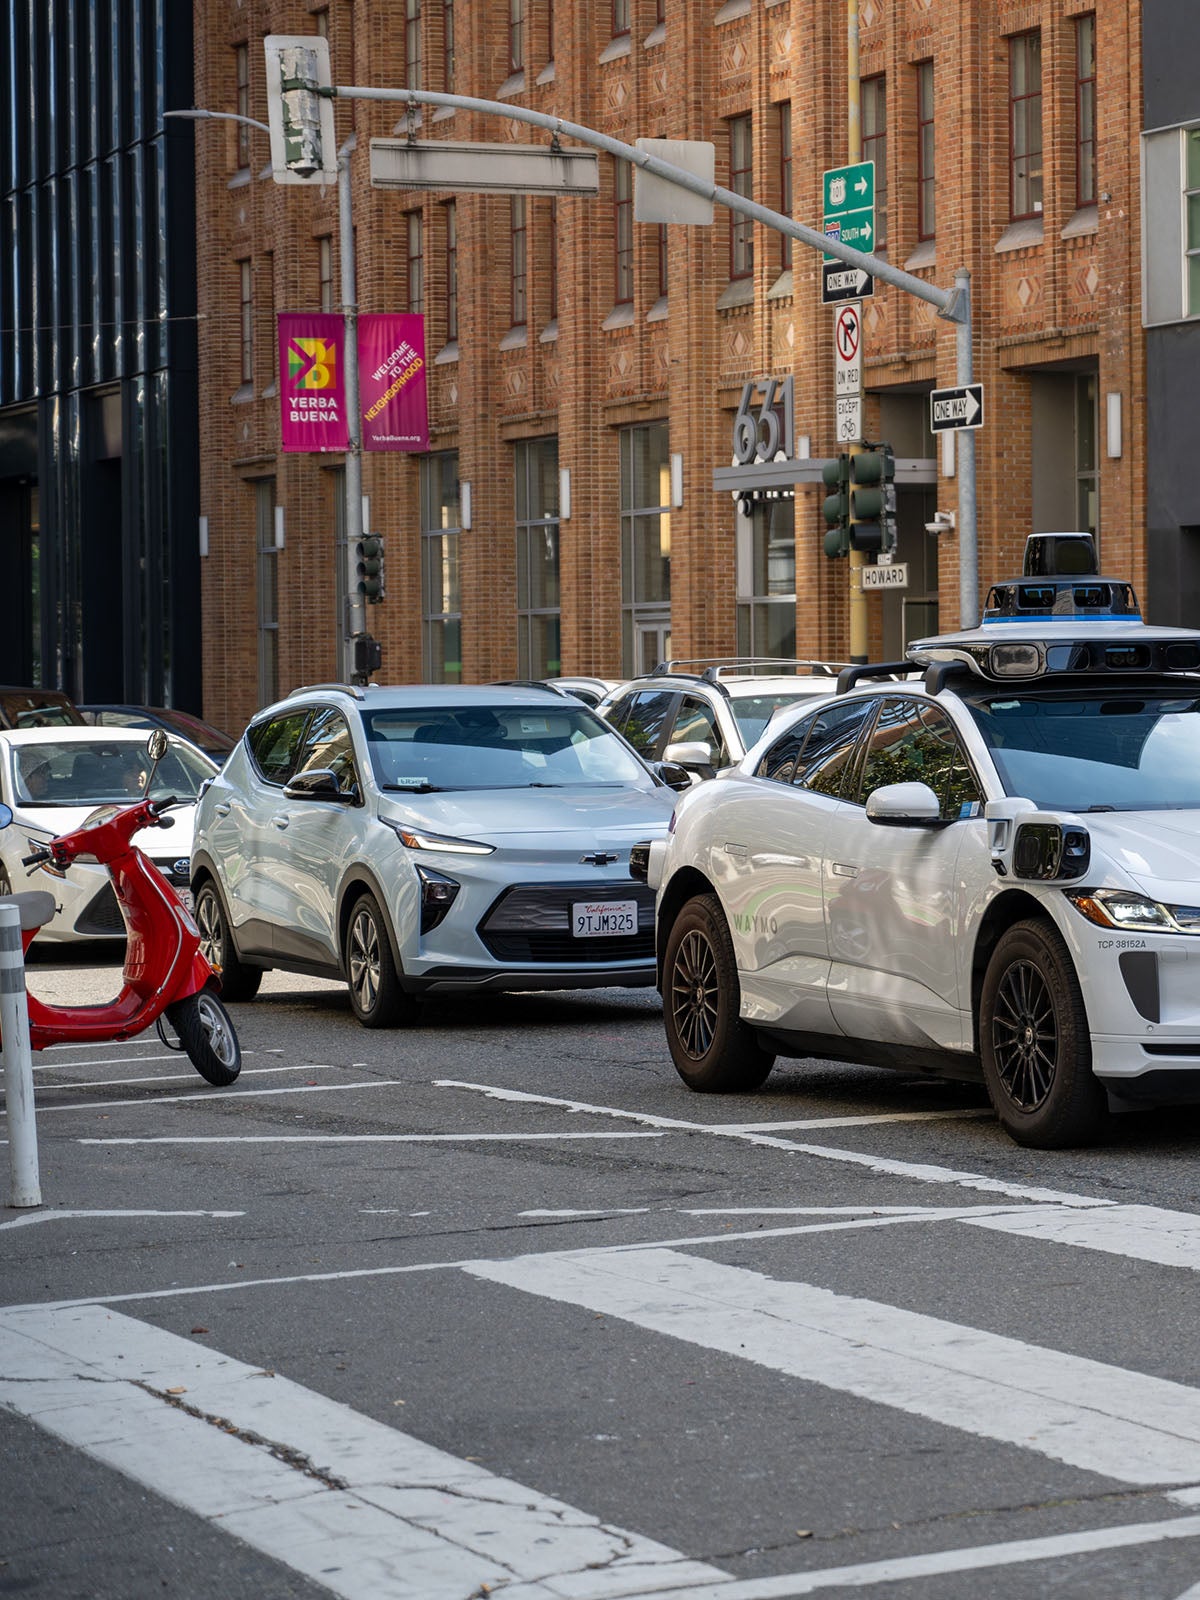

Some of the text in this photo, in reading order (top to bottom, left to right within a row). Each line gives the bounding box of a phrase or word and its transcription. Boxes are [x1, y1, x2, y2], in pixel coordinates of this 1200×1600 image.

[832, 186, 842, 198] 101
[841, 227, 859, 241] SOUTH
[828, 272, 858, 289] ONE WAY
[371, 340, 410, 382] WELCOME
[388, 348, 418, 379] TO THE
[838, 368, 858, 385] ON RED
[364, 357, 424, 422] NEIGHBORHOOD
[289, 397, 338, 409] YERBA
[838, 401, 859, 415] EXCEPT
[936, 399, 967, 420] ONE WAY
[290, 411, 339, 422] BUENA
[734, 375, 795, 464] 631
[865, 569, 904, 584] HOWARD
[586, 905, 625, 915] California
[577, 914, 634, 933] 9TJM325
[733, 914, 778, 935] WAYMO
[1097, 940, 1146, 949] TCP 38152A
